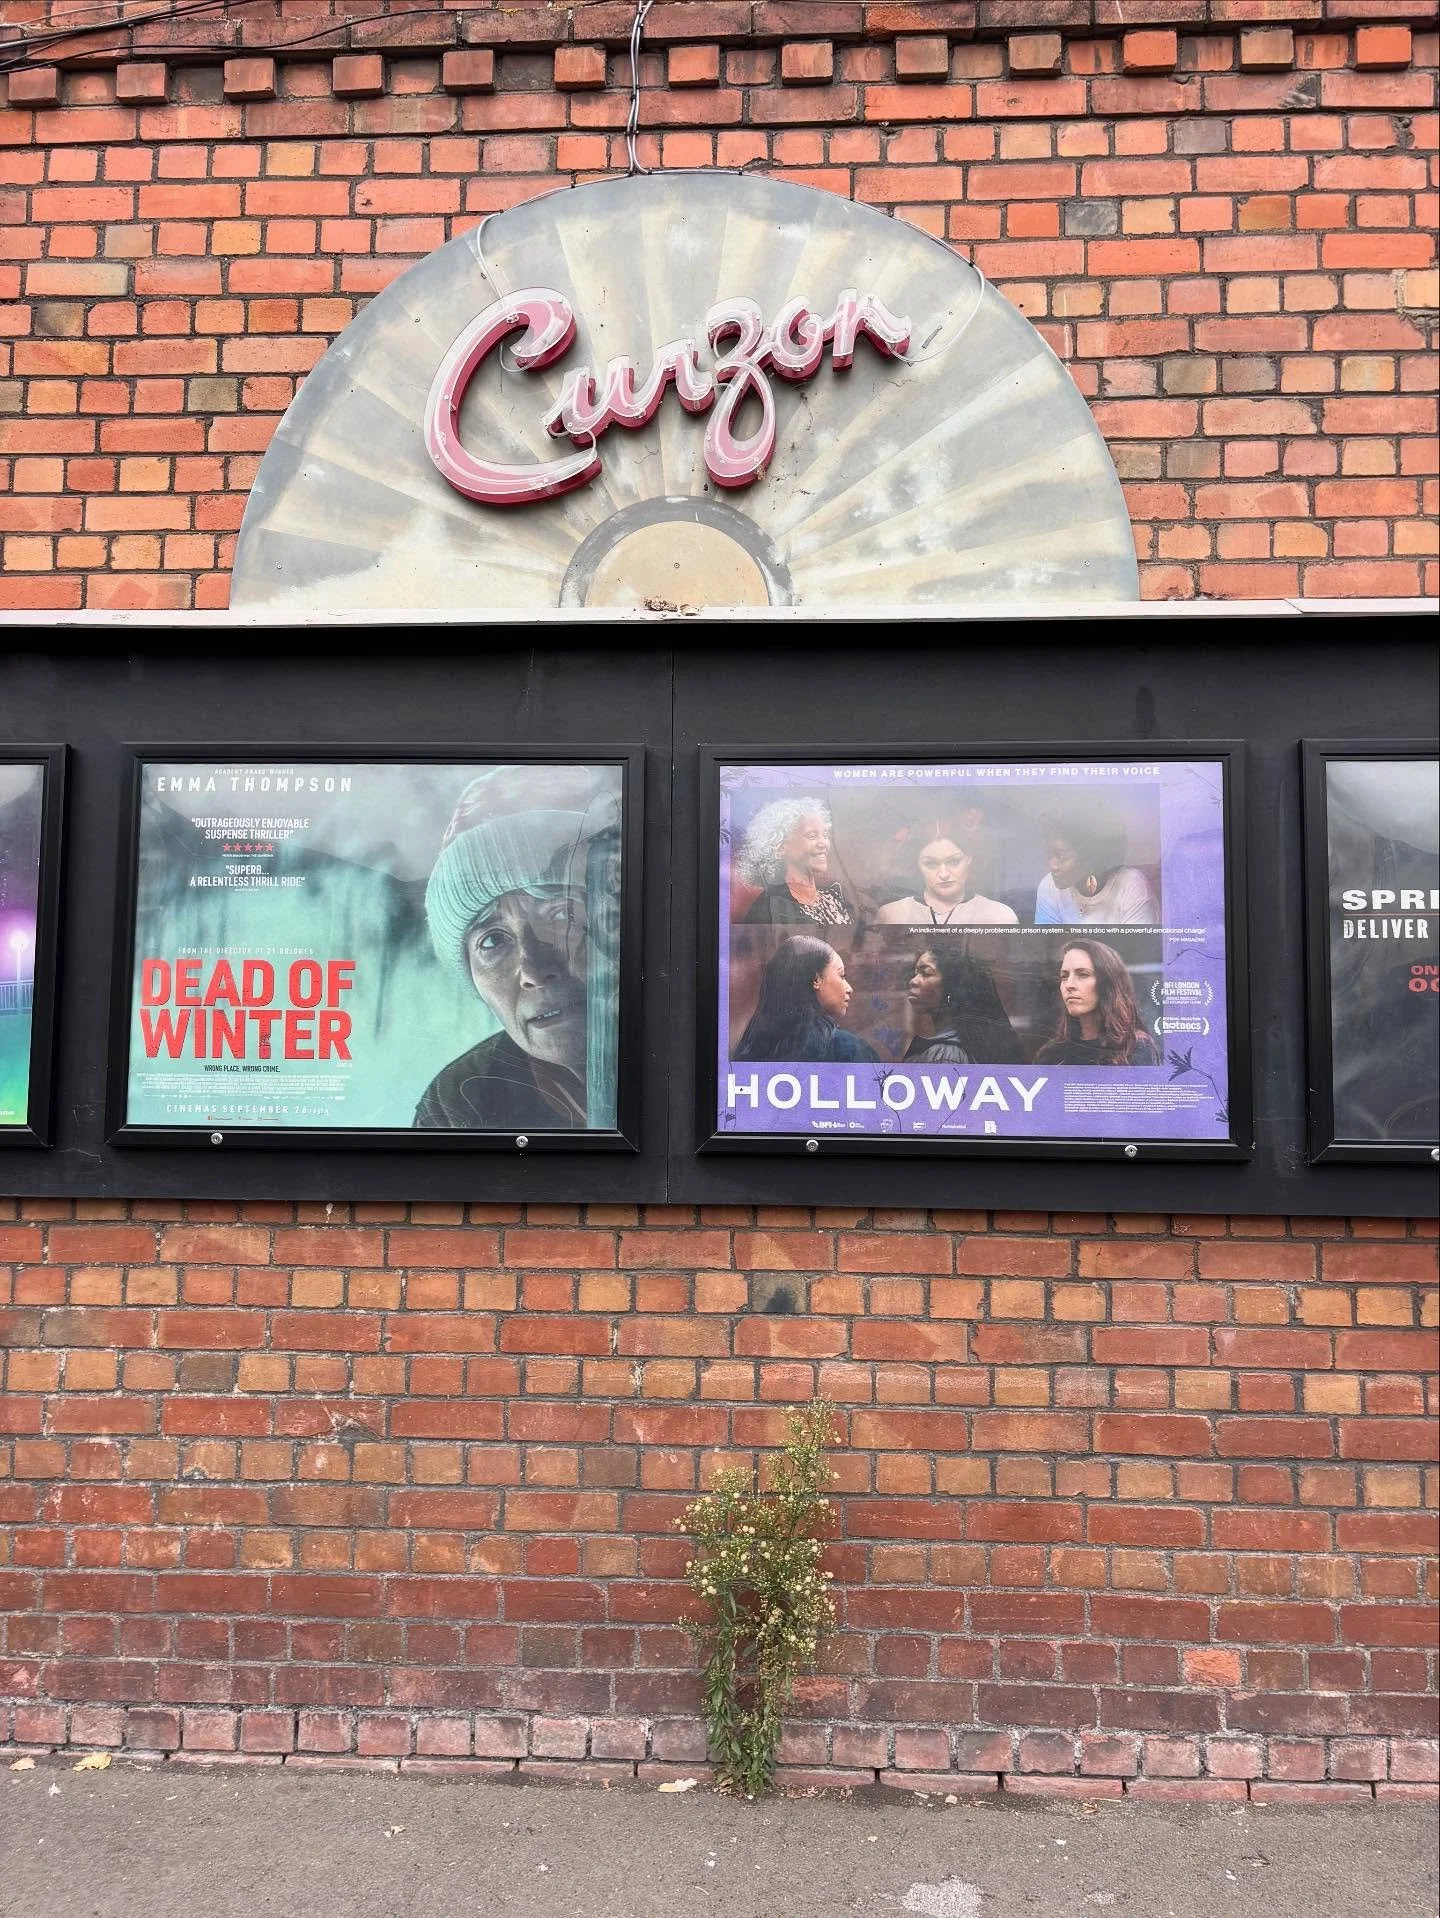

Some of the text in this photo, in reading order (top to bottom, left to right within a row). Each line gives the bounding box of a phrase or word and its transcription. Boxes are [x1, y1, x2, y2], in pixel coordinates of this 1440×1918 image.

[423, 286, 912, 507] Curzon
[833, 766, 1161, 778] WOMEN ARE POWERFUL WHEN THEY FIND THEIR VOICE
[157, 776, 352, 792] EMMA THOMPSON
[261, 818, 310, 829] ENJOYABLE
[205, 829, 295, 839] SUSPENSE THRILLER"
[189, 876, 306, 887] A RELENTLESS THRILL RIDE"
[1342, 889, 1439, 911] SPRI
[963, 927, 984, 935] deeply
[984, 927, 1020, 935] problematic
[1021, 927, 1041, 935] prison
[1124, 927, 1153, 935] powerful
[1343, 918, 1429, 939] DELIVER
[141, 958, 356, 1009] DEAD OF
[1174, 981, 1200, 989] LONDON
[1161, 988, 1176, 996] FILM
[139, 1008, 353, 1061] WINTER
[204, 1064, 223, 1072] WRONG
[242, 1065, 262, 1073] WRONG
[727, 1073, 1049, 1112] HOLLOWAY
[166, 1104, 217, 1113] CINEMAS
[222, 1104, 289, 1114] SEPTEMBER
